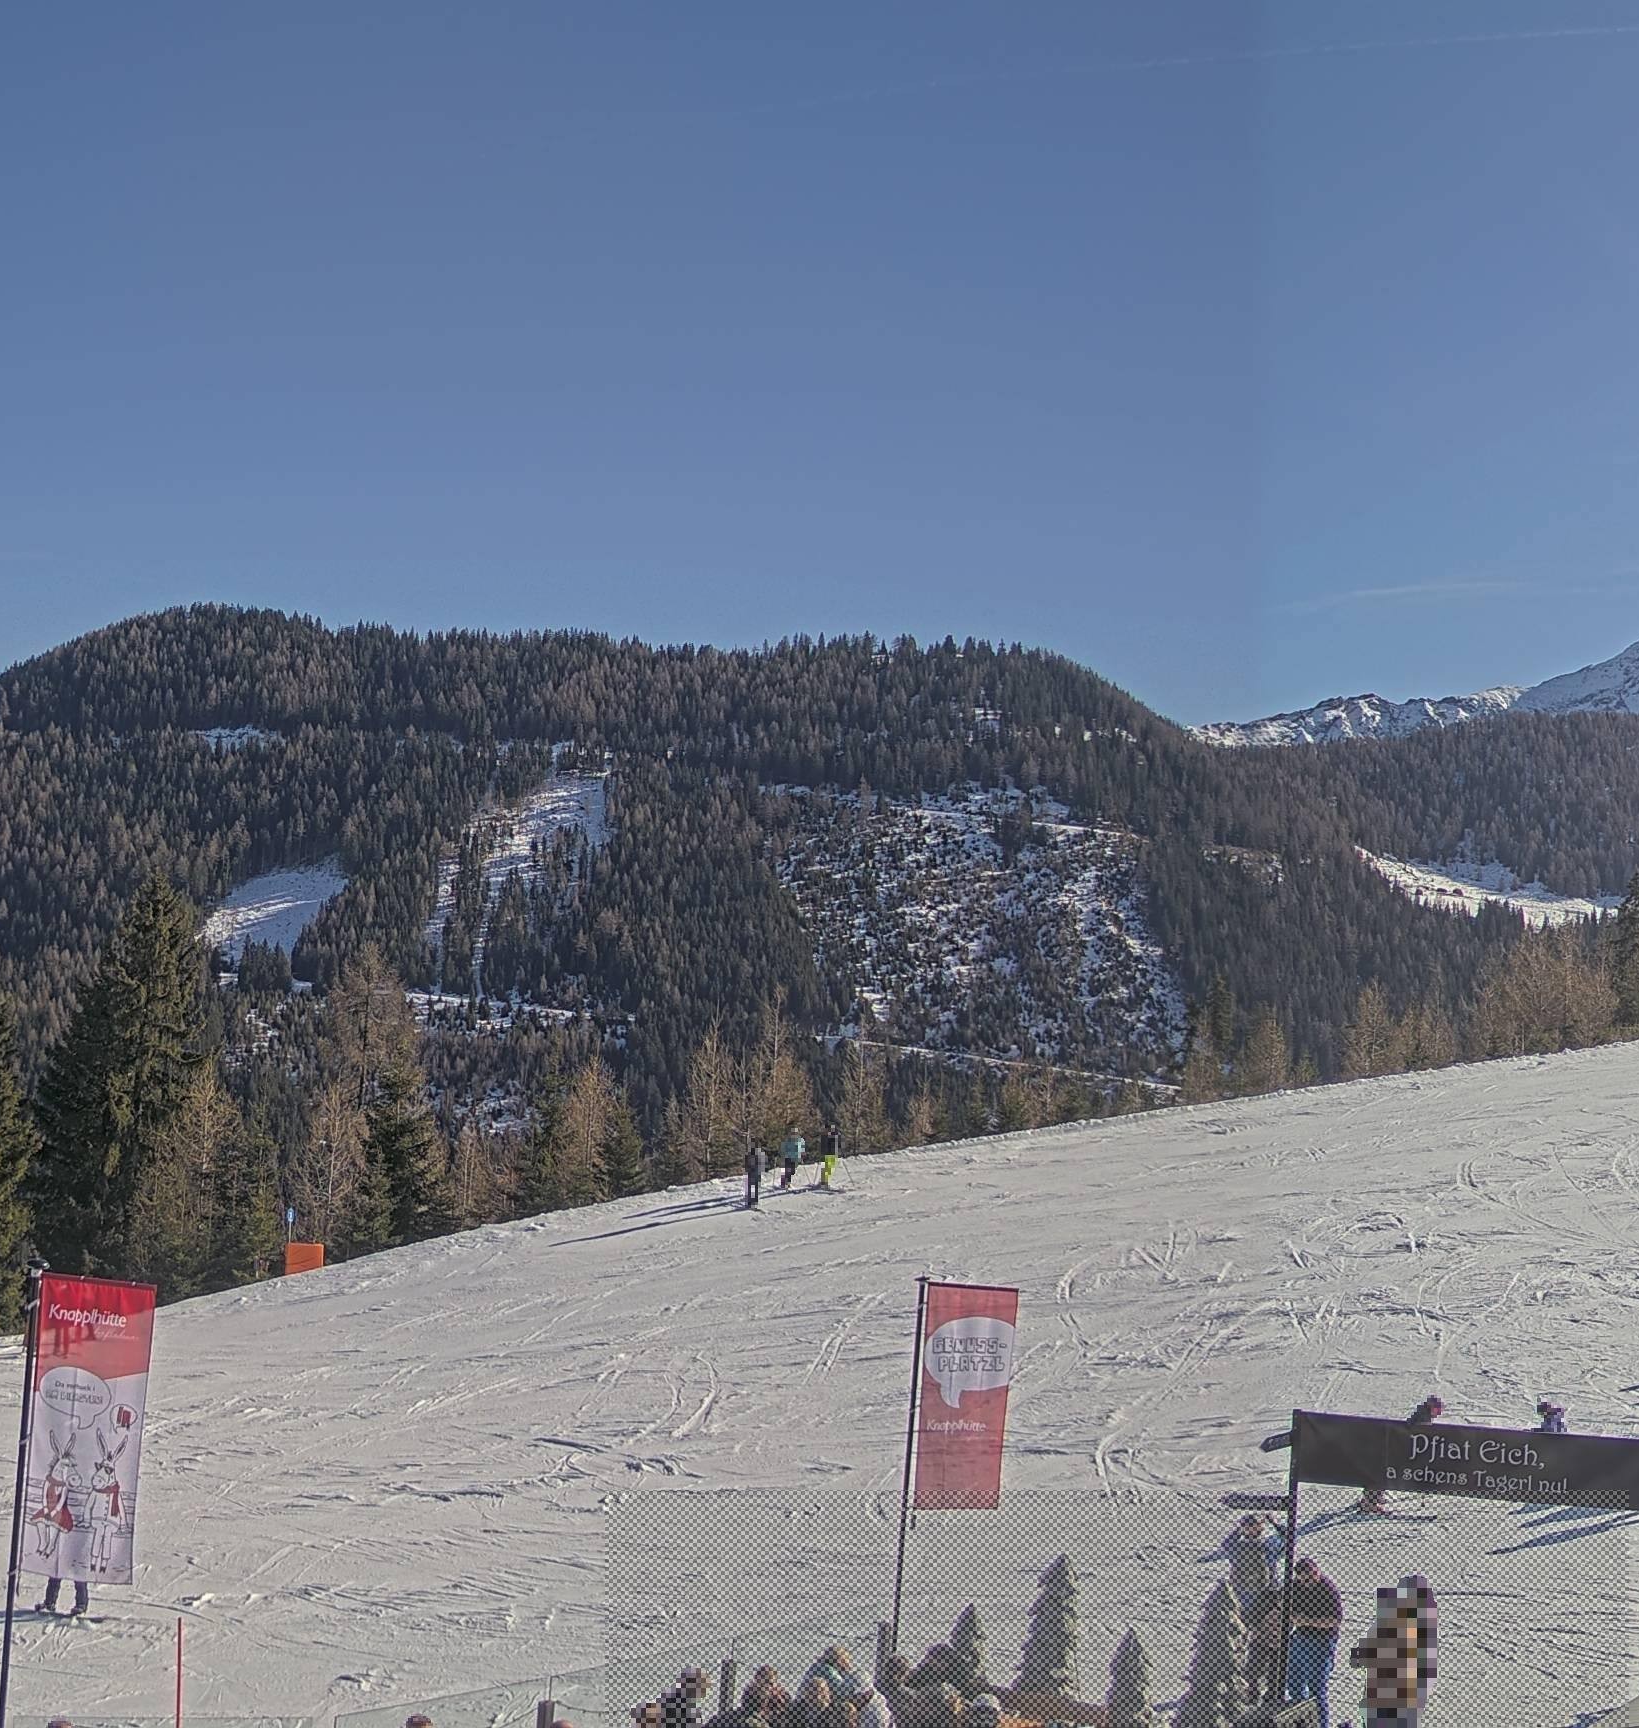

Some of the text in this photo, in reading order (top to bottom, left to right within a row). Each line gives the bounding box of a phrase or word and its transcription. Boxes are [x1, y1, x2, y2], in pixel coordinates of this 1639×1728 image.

[49, 1303, 127, 1327] Knapplhütte
[932, 1336, 1007, 1354] GENUSS-
[937, 1355, 1005, 1372] PLATZL
[927, 1418, 987, 1434] Knapplhütte
[1409, 1433, 1545, 1469] Pfiat Eich,
[1386, 1466, 1397, 1479] a
[1402, 1466, 1468, 1486] schens
[1473, 1470, 1532, 1492] Tagerl
